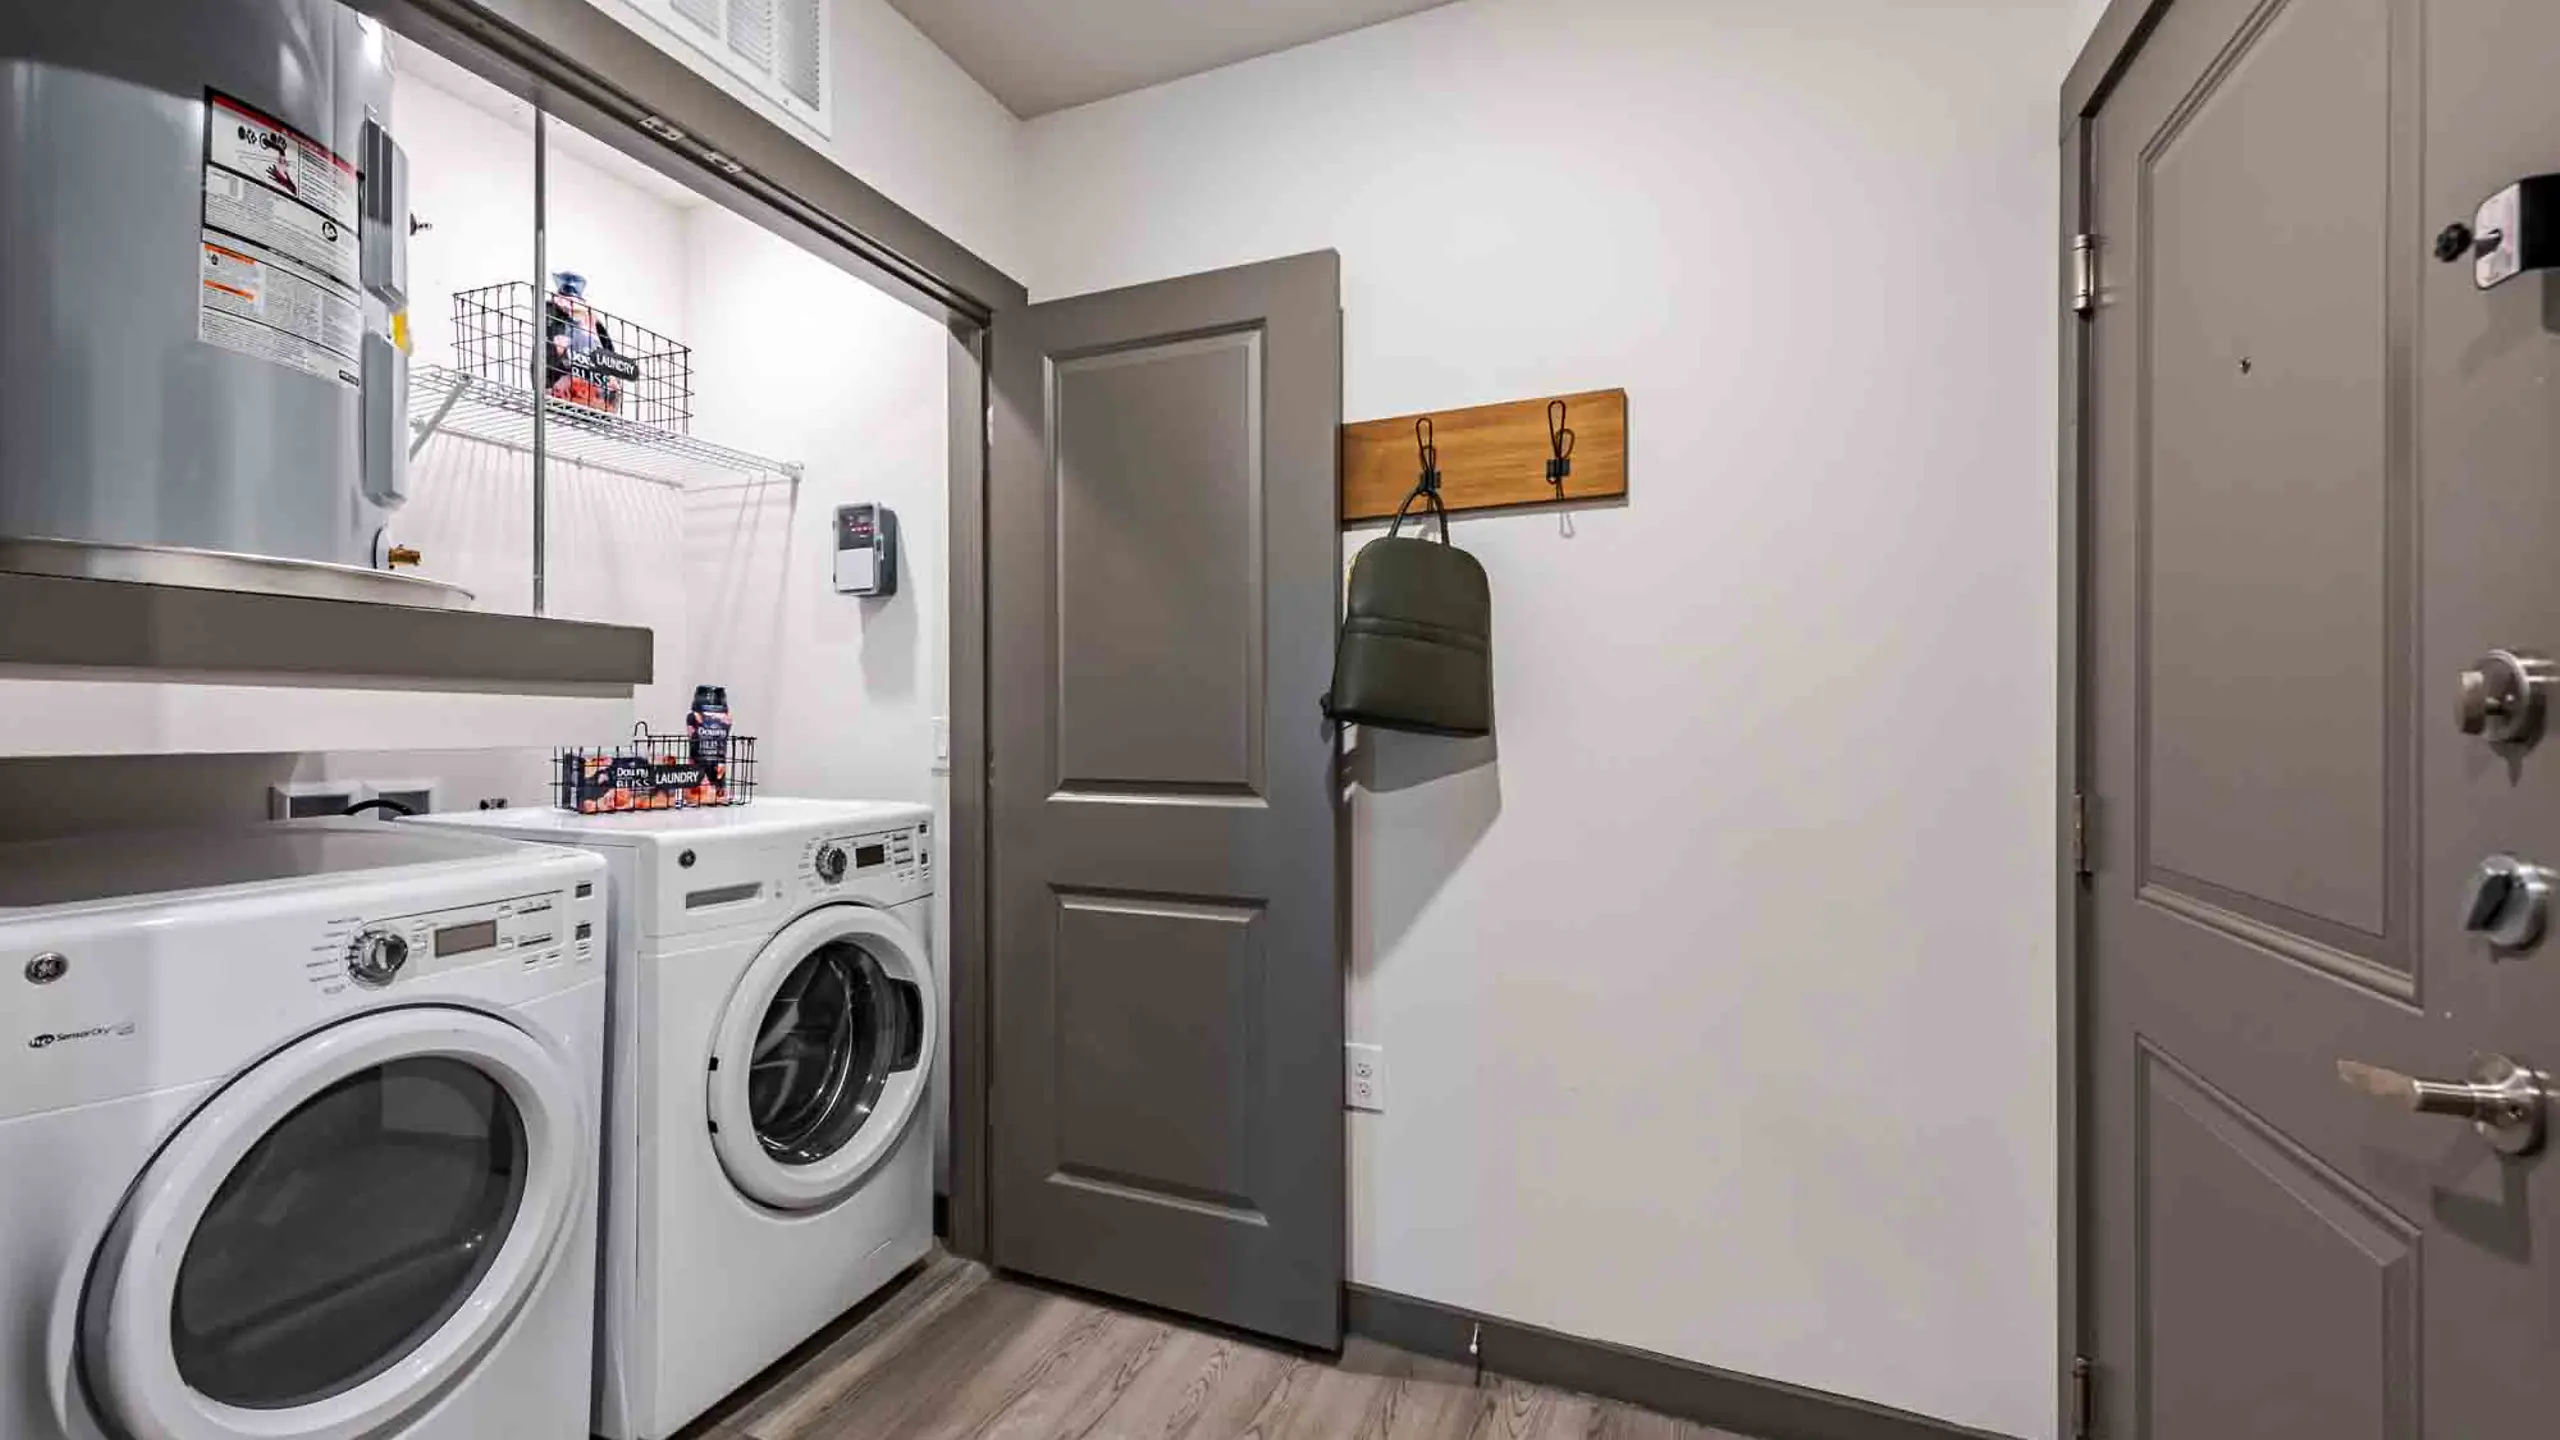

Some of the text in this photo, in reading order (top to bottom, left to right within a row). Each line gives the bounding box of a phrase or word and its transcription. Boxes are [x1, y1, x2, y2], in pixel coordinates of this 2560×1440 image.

[596, 353, 634, 376] LAUNDRY
[616, 767, 649, 779] Downy
[655, 771, 699, 785] LAUNDRY
